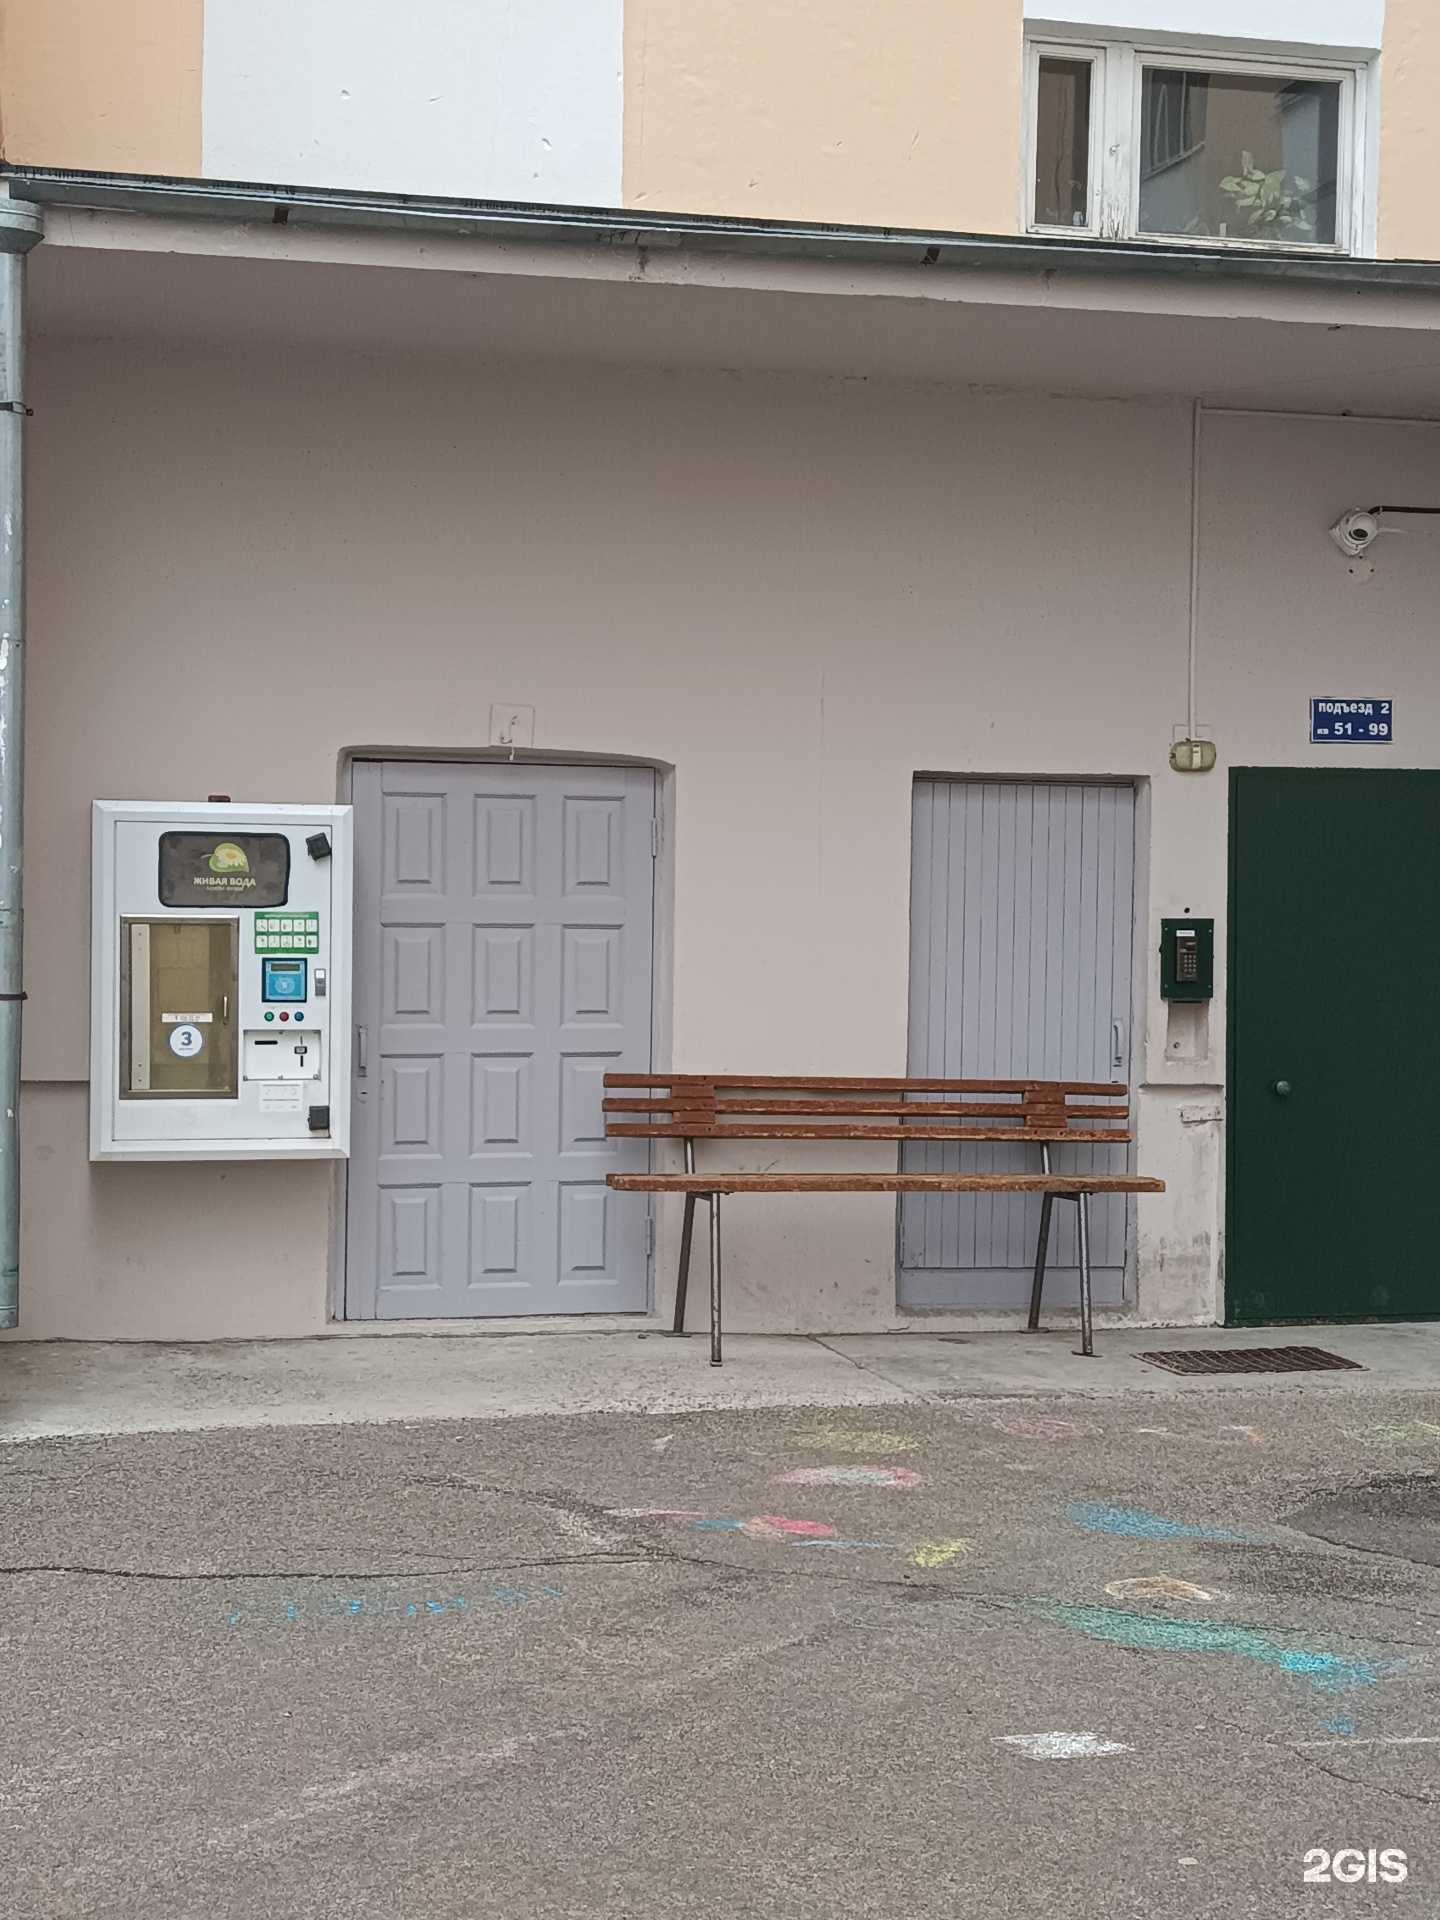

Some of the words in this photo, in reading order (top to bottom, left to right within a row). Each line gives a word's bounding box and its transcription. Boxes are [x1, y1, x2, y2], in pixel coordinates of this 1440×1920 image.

[1380, 702, 1390, 714] 2
[1334, 722, 1353, 735] 51
[1368, 723, 1389, 736] 99
[193, 877, 228, 886] ЖИВАЯ
[229, 877, 257, 889] ВОДА
[181, 1031, 192, 1046] 3
